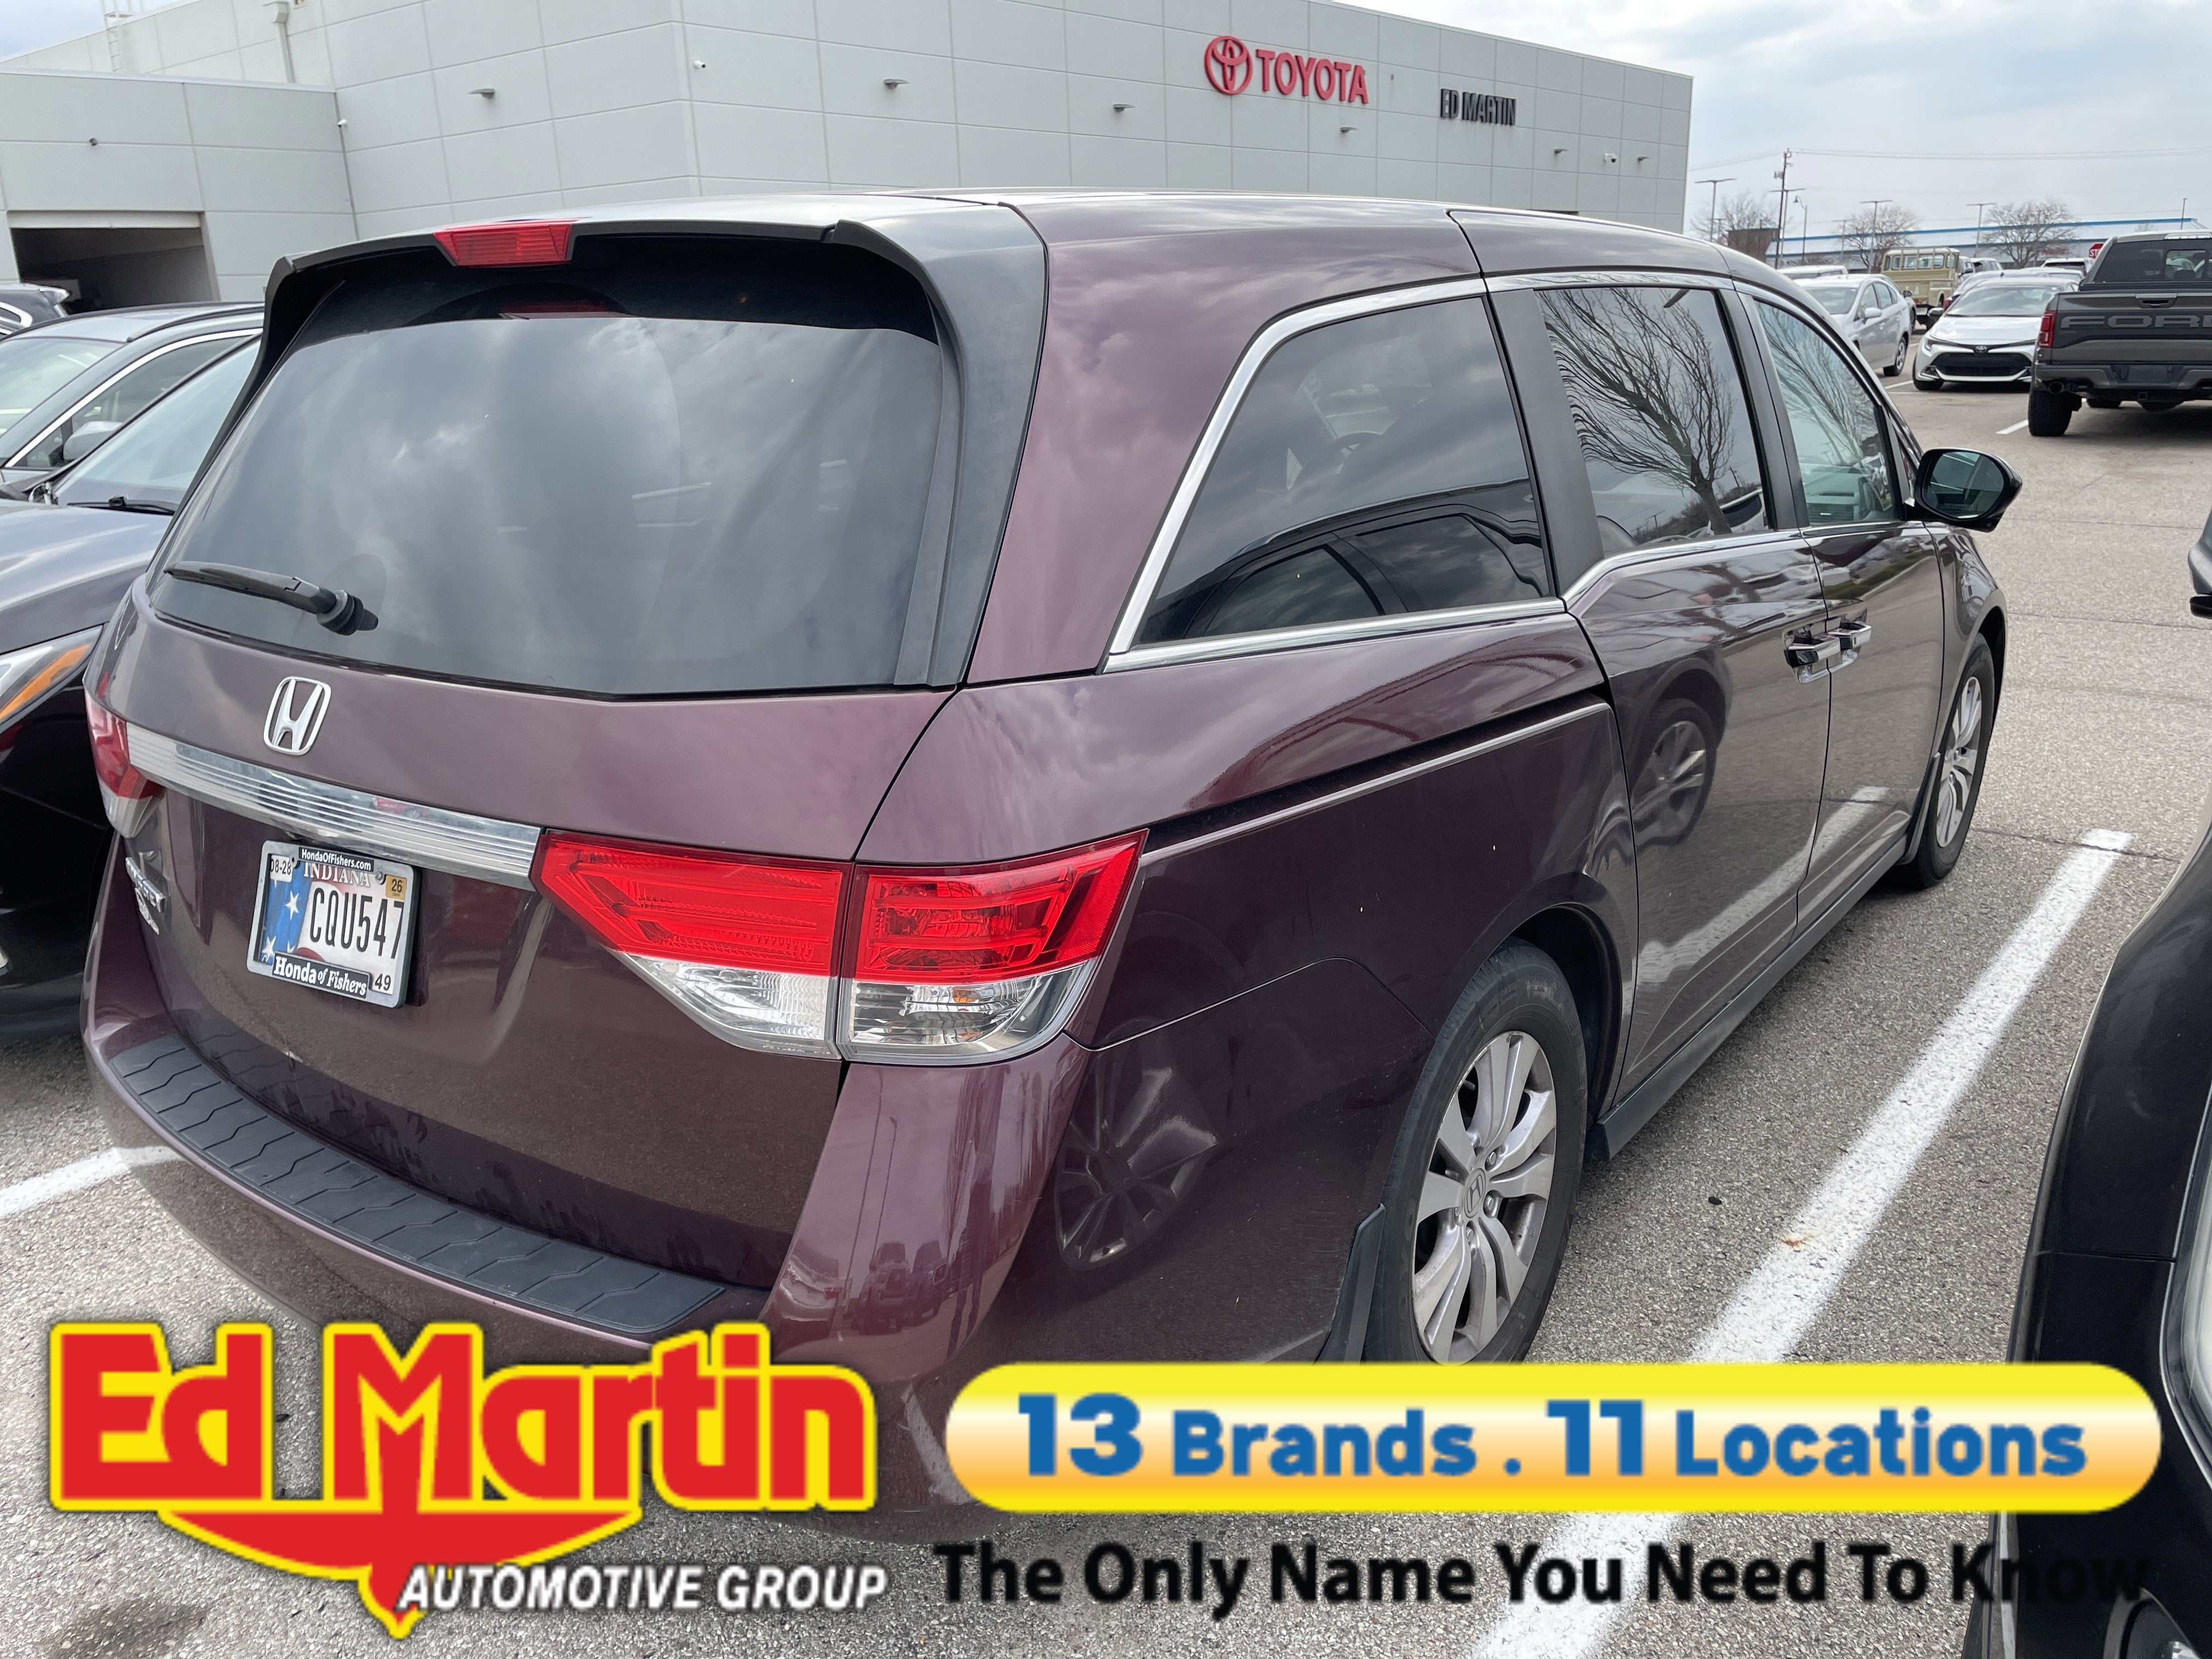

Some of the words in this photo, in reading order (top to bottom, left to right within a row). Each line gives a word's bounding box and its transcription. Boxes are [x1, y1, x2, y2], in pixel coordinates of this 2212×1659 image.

[1256, 48, 1369, 105] TOYOTA
[1440, 88, 1460, 119] ED
[1462, 91, 1516, 126] MARTIN
[2061, 314, 2212, 329] FOR
[301, 849, 371, 871] HondaOfFishers.com
[303, 862, 371, 887] INDIANA
[391, 878, 403, 893] 26
[309, 887, 405, 960] CQU547
[274, 956, 317, 984] Honda
[317, 968, 328, 985] of
[326, 970, 367, 996] Fishers
[375, 973, 391, 991] 49
